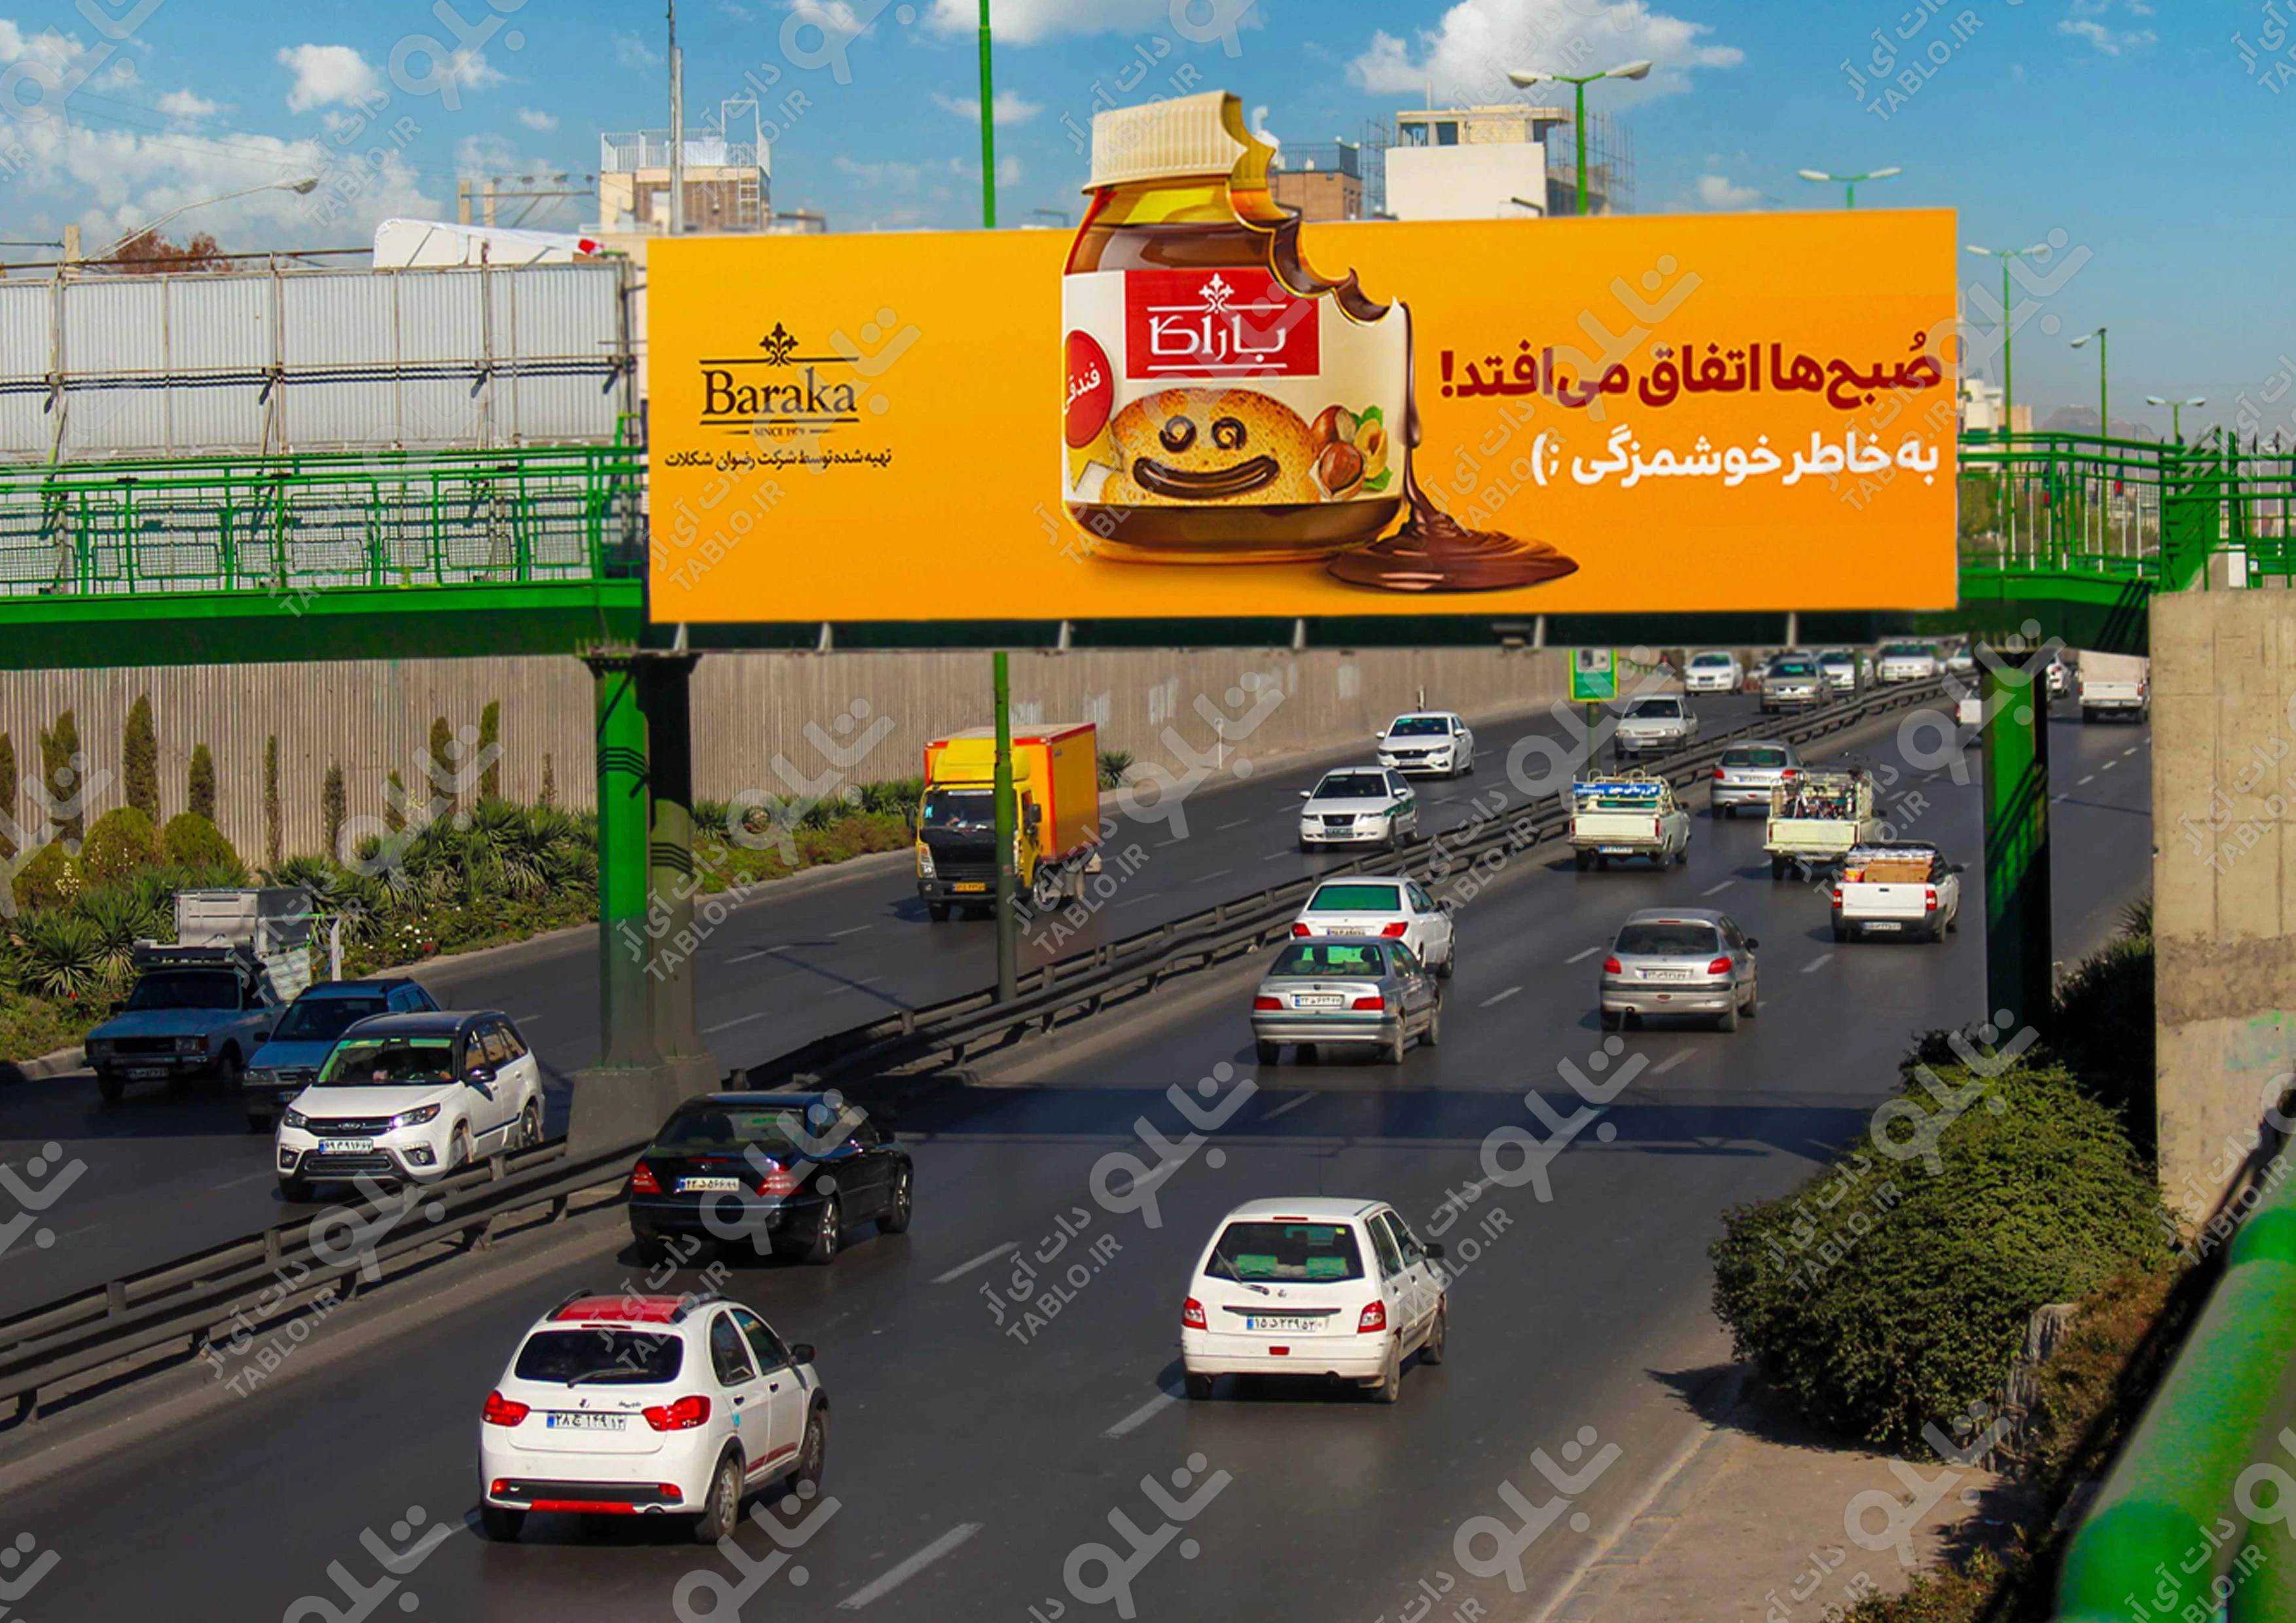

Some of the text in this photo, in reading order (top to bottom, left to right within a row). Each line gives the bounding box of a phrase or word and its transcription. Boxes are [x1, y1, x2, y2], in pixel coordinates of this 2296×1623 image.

[702, 366, 857, 415] Baraka
[1638, 342, 1761, 408] اتفاق
[753, 427, 783, 437] SINCE
[1572, 424, 1782, 488] خوشمزگی
[664, 448, 892, 472] تهیه شده توسط شرکت رضوان شکلات
[1782, 430, 1892, 486] خاطر
[1896, 439, 1939, 486] به
